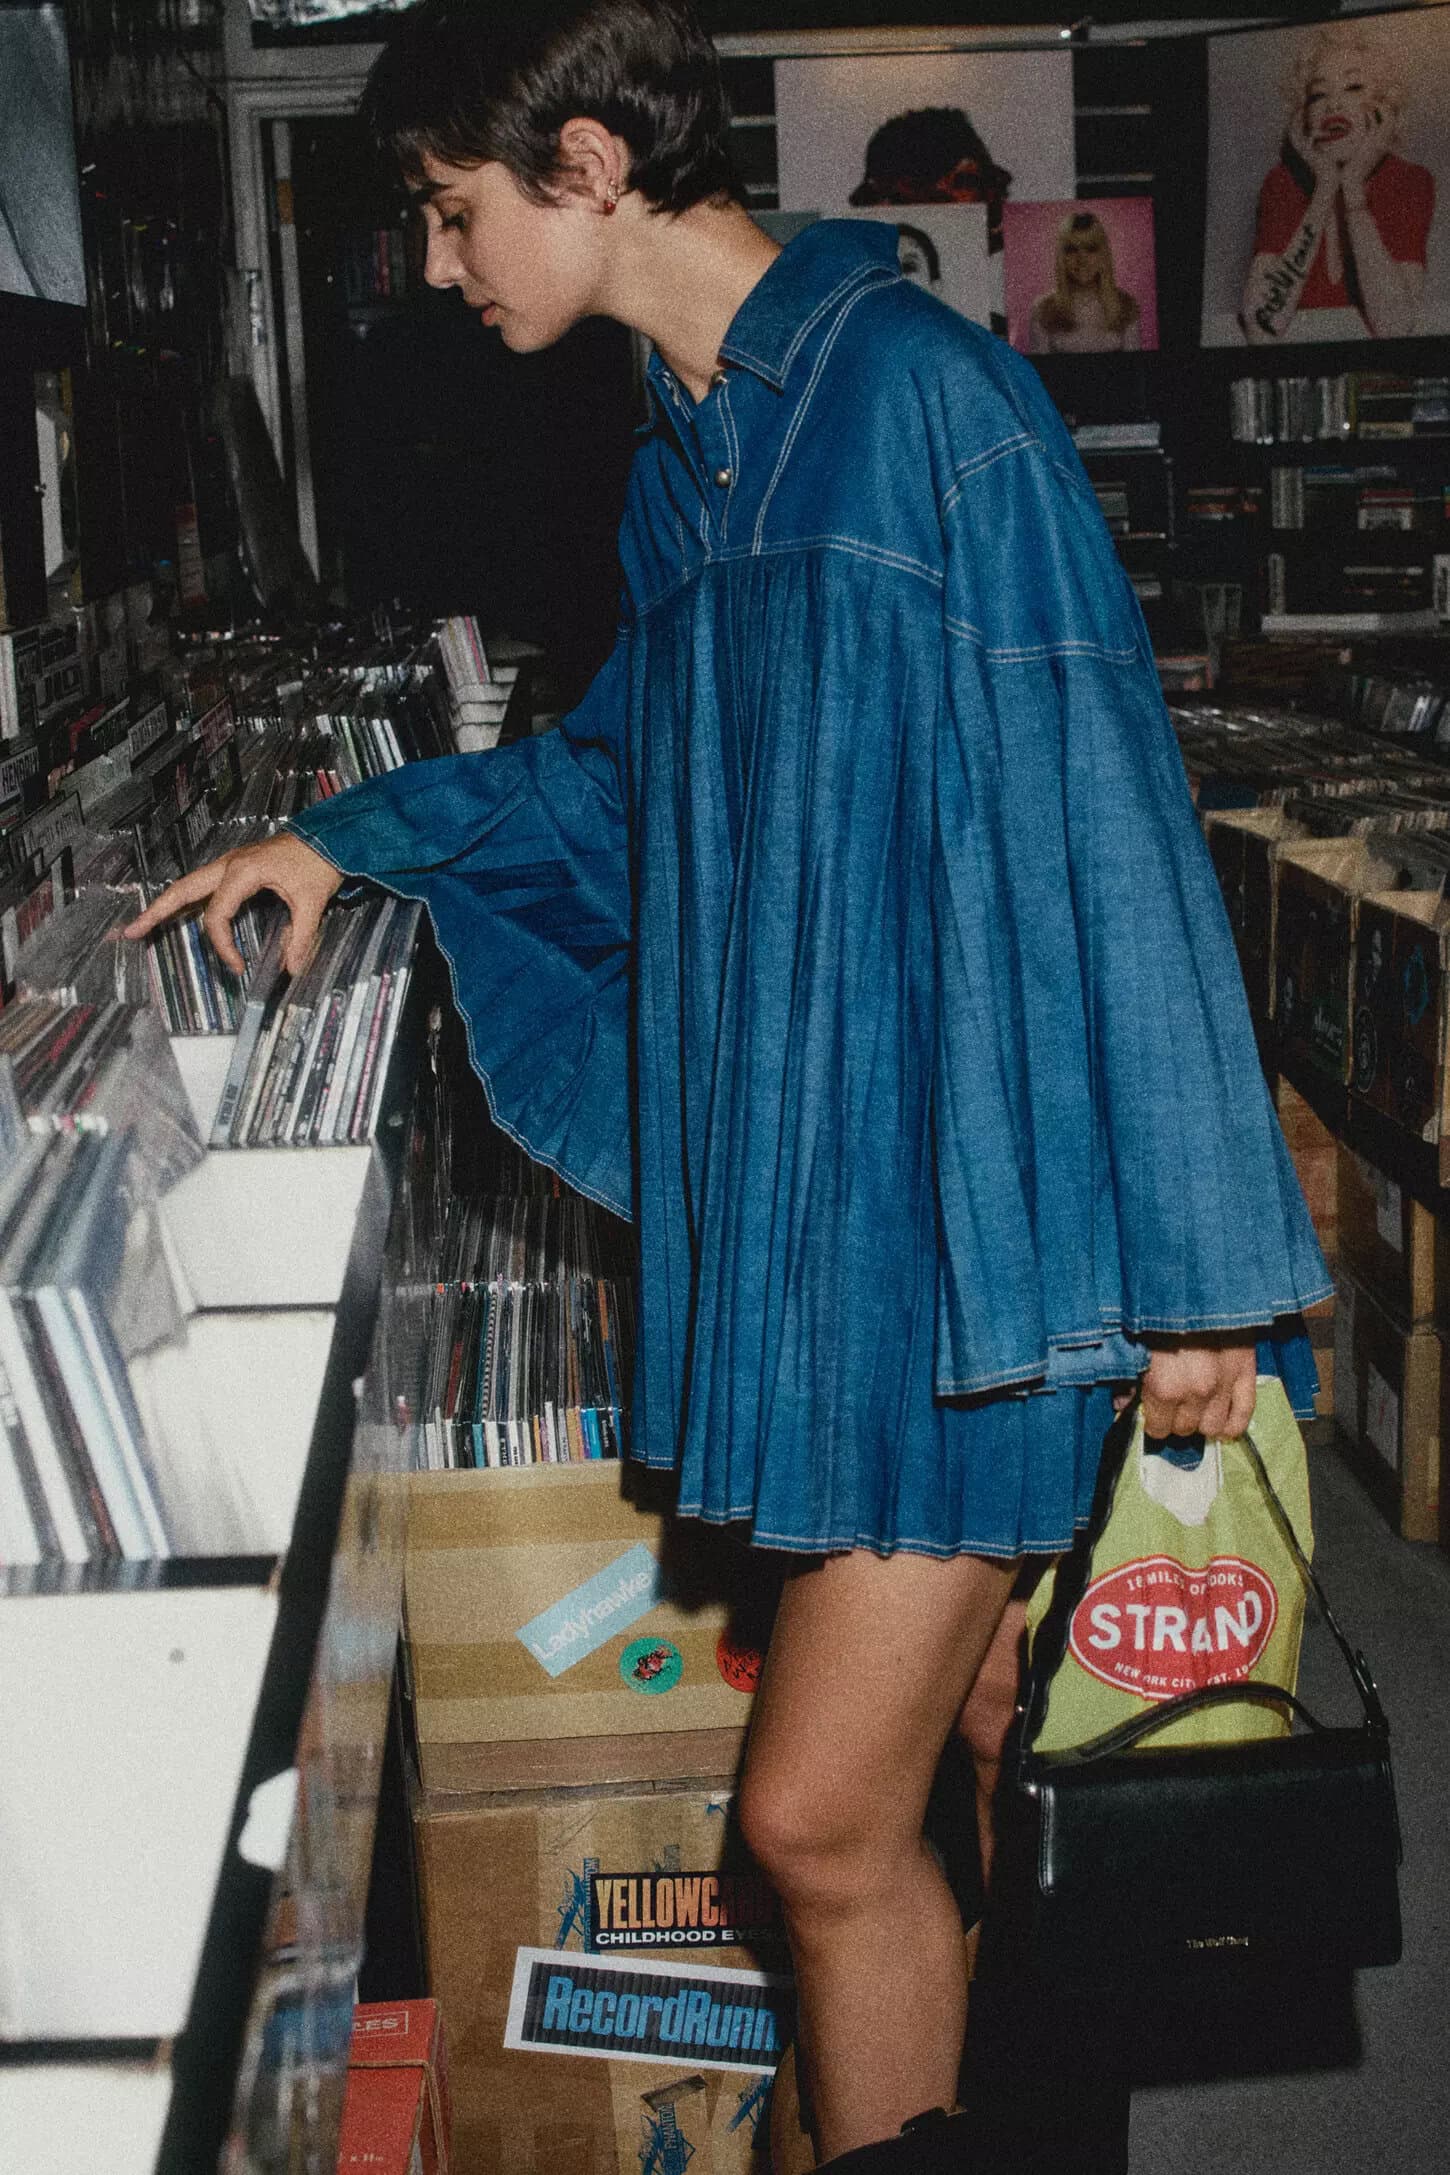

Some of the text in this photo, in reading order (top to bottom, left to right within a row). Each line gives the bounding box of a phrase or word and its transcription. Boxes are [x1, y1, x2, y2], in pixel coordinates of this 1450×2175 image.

[531, 1569, 654, 1661] Ladyhawke
[1088, 1590, 1263, 1656] STRAND
[1114, 1661, 1142, 1679] NEW
[595, 1930, 717, 1945] CHILDHOOD
[543, 1976, 782, 2051] RecordRunn
